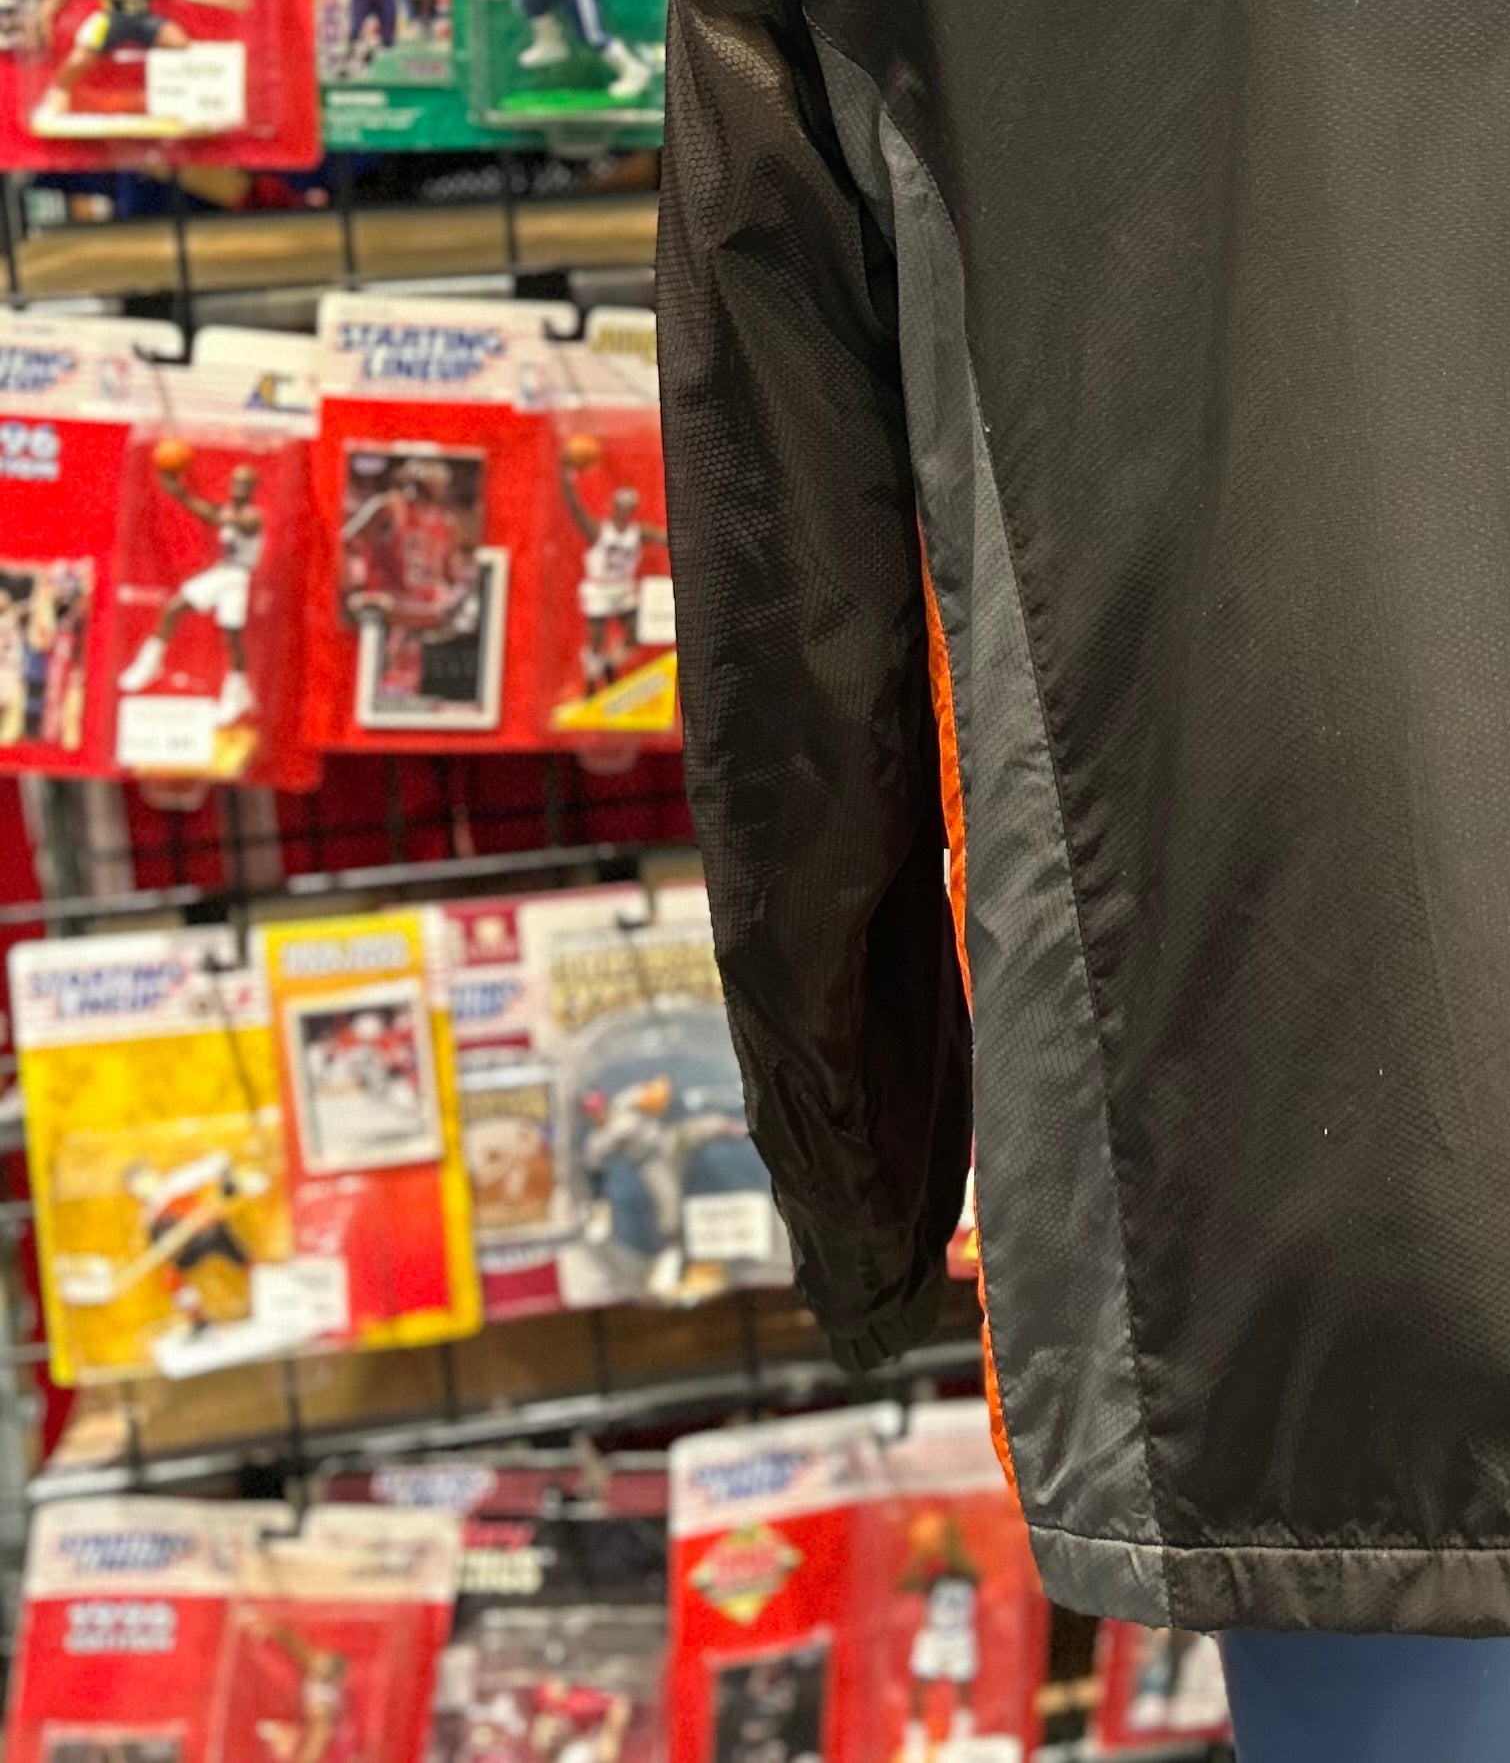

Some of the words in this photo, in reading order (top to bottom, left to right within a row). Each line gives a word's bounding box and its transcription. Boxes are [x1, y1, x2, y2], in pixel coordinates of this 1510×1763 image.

[340, 324, 503, 354] STARTING
[364, 356, 482, 380] LINEUP
[0, 423, 60, 458] 96
